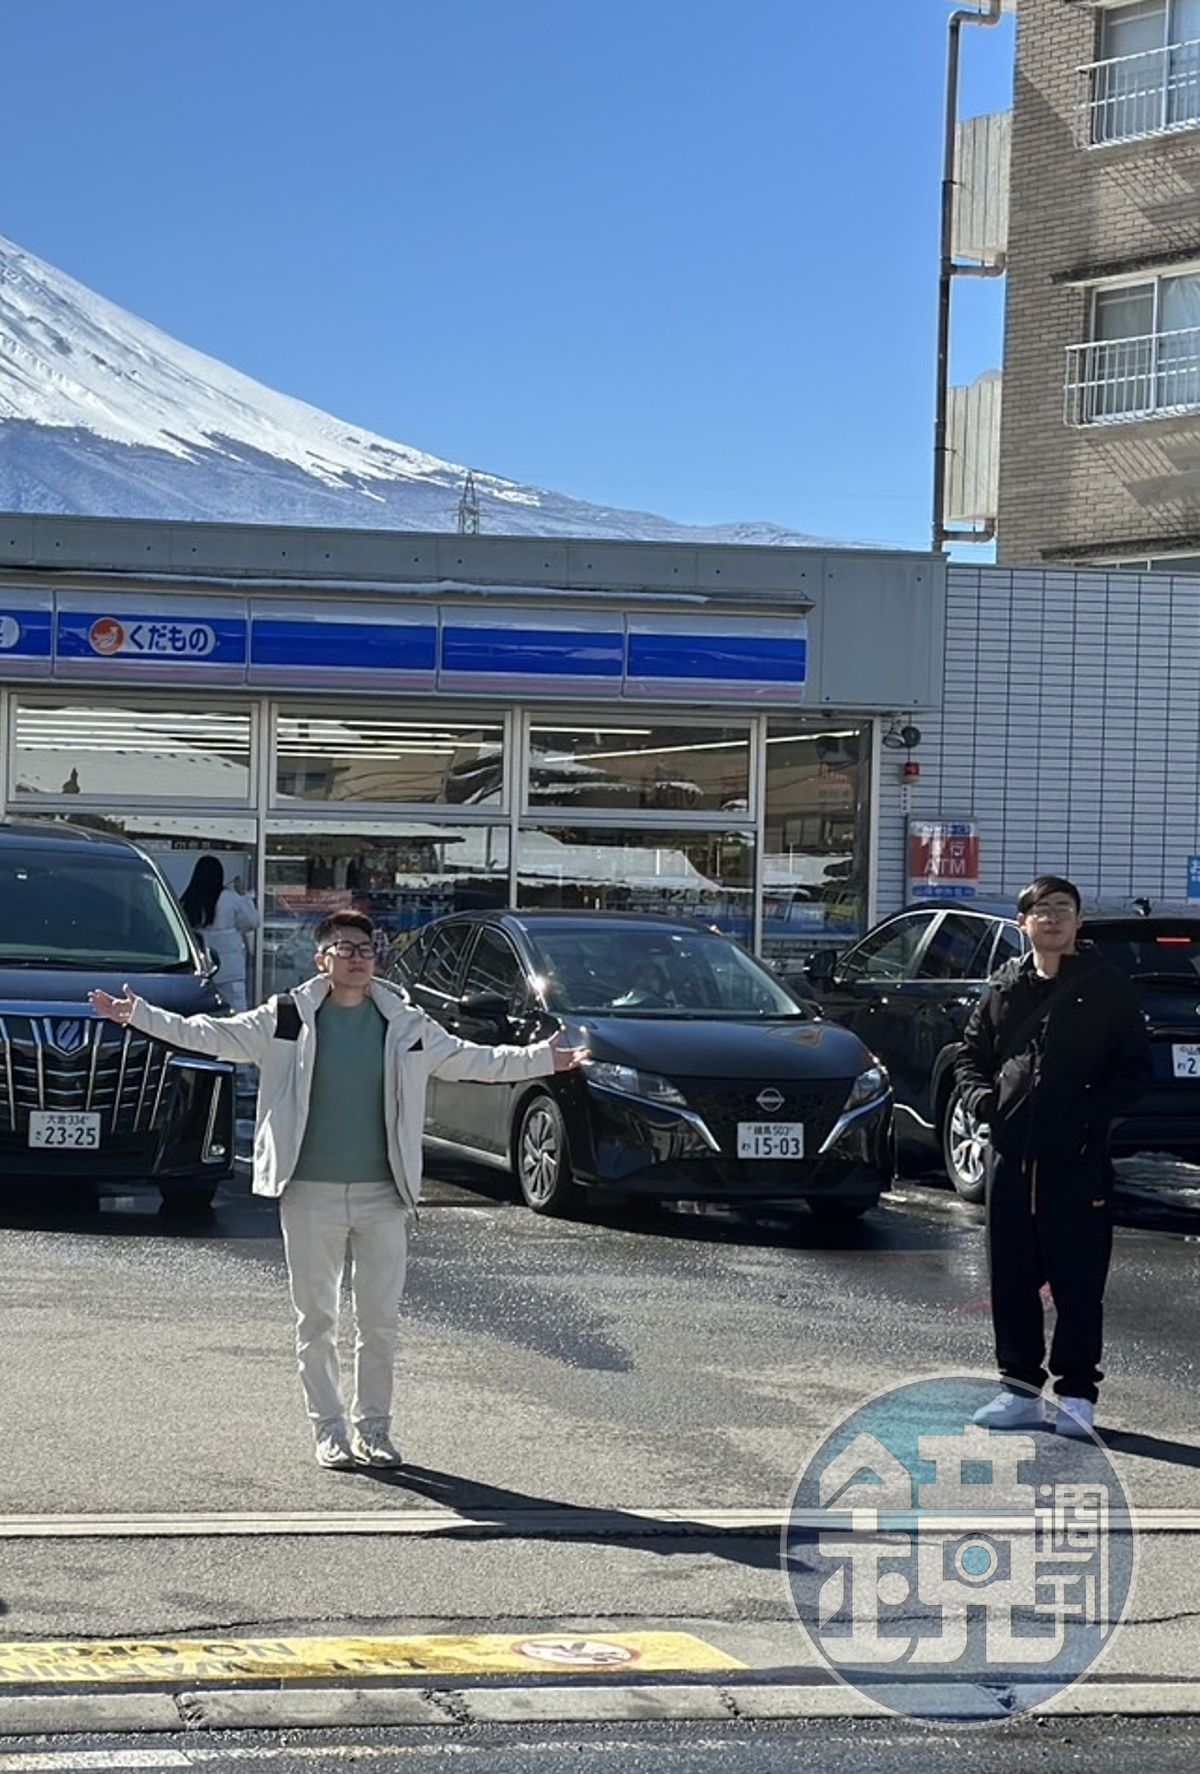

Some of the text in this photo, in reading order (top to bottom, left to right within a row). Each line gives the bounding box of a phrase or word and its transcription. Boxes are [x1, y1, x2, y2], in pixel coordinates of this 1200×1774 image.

[128, 624, 210, 653] くだもの
[923, 859, 966, 876] ATM
[44, 1126, 97, 1146] 23-25
[754, 1136, 801, 1156] 15-03
